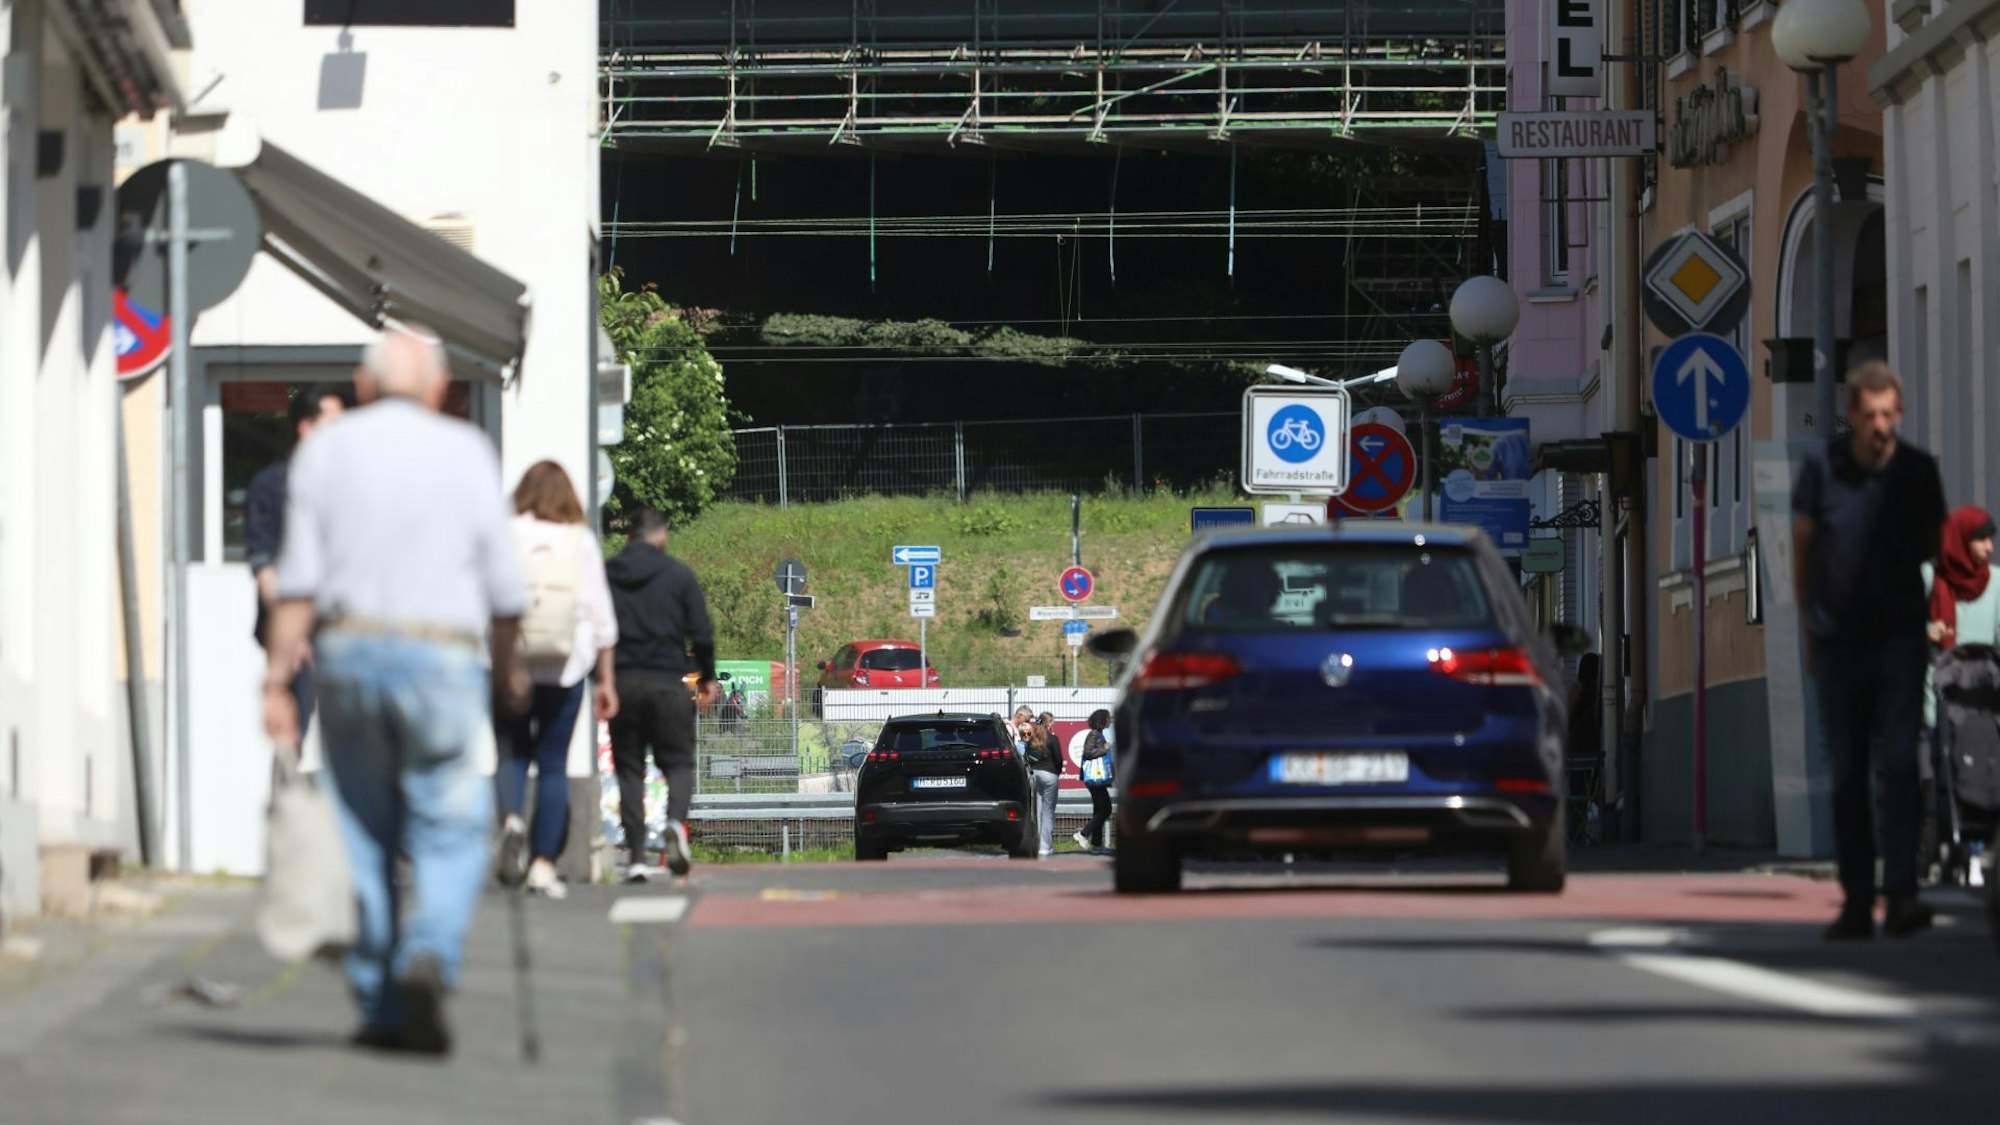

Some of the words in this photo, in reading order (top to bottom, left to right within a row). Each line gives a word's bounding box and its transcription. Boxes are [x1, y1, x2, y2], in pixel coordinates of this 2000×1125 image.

[1511, 119, 1643, 149] RESTAURANT
[1256, 468, 1335, 481] Fahrradstraße
[914, 567, 929, 586] P
